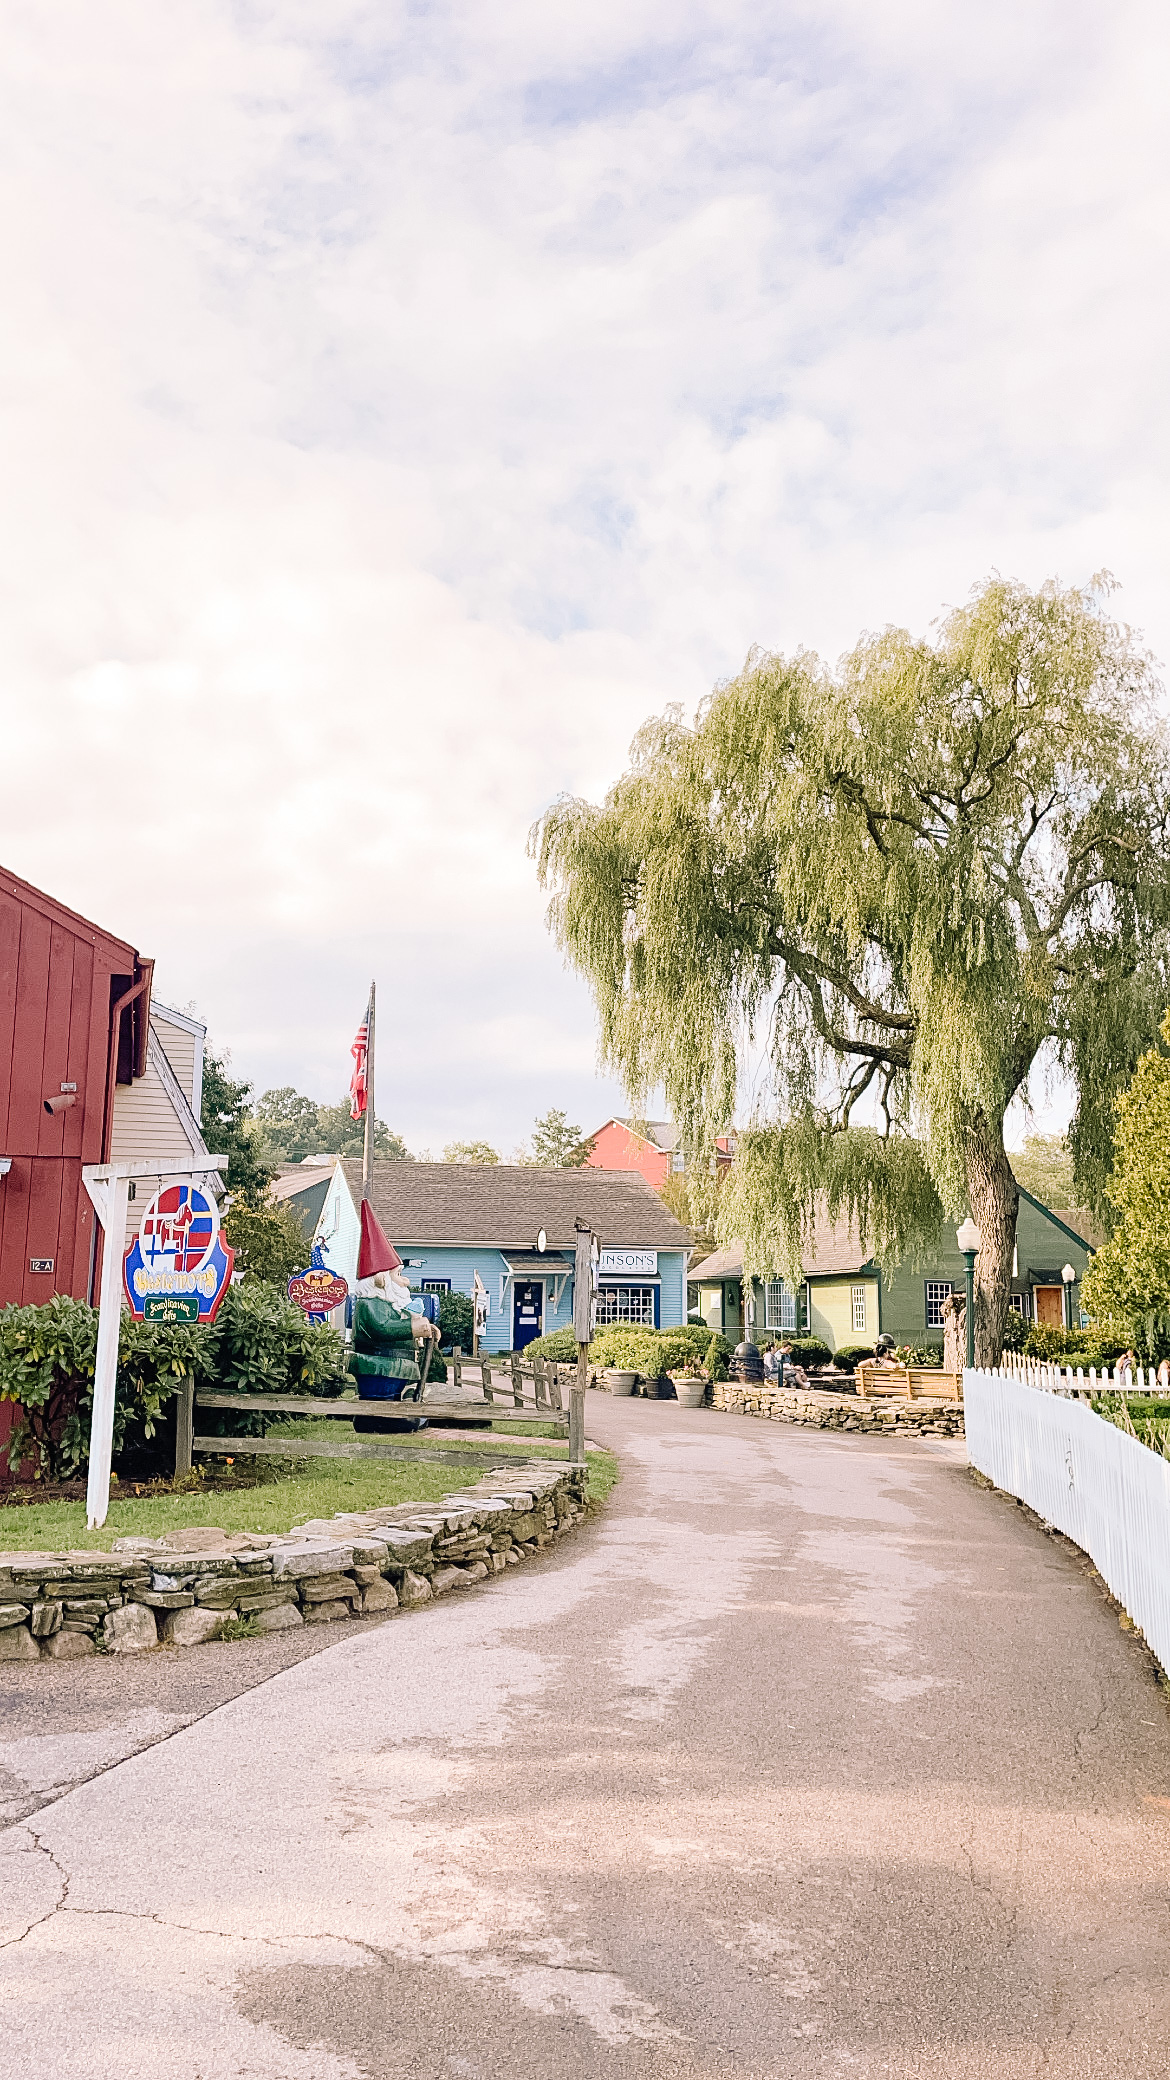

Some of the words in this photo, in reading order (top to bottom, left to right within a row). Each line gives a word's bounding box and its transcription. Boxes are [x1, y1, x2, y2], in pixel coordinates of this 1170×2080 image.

[601, 1255, 654, 1265] UNSON'S
[32, 1261, 51, 1270] 12-A
[150, 1298, 191, 1317] Scandinavian
[162, 1309, 177, 1320] Gifts
